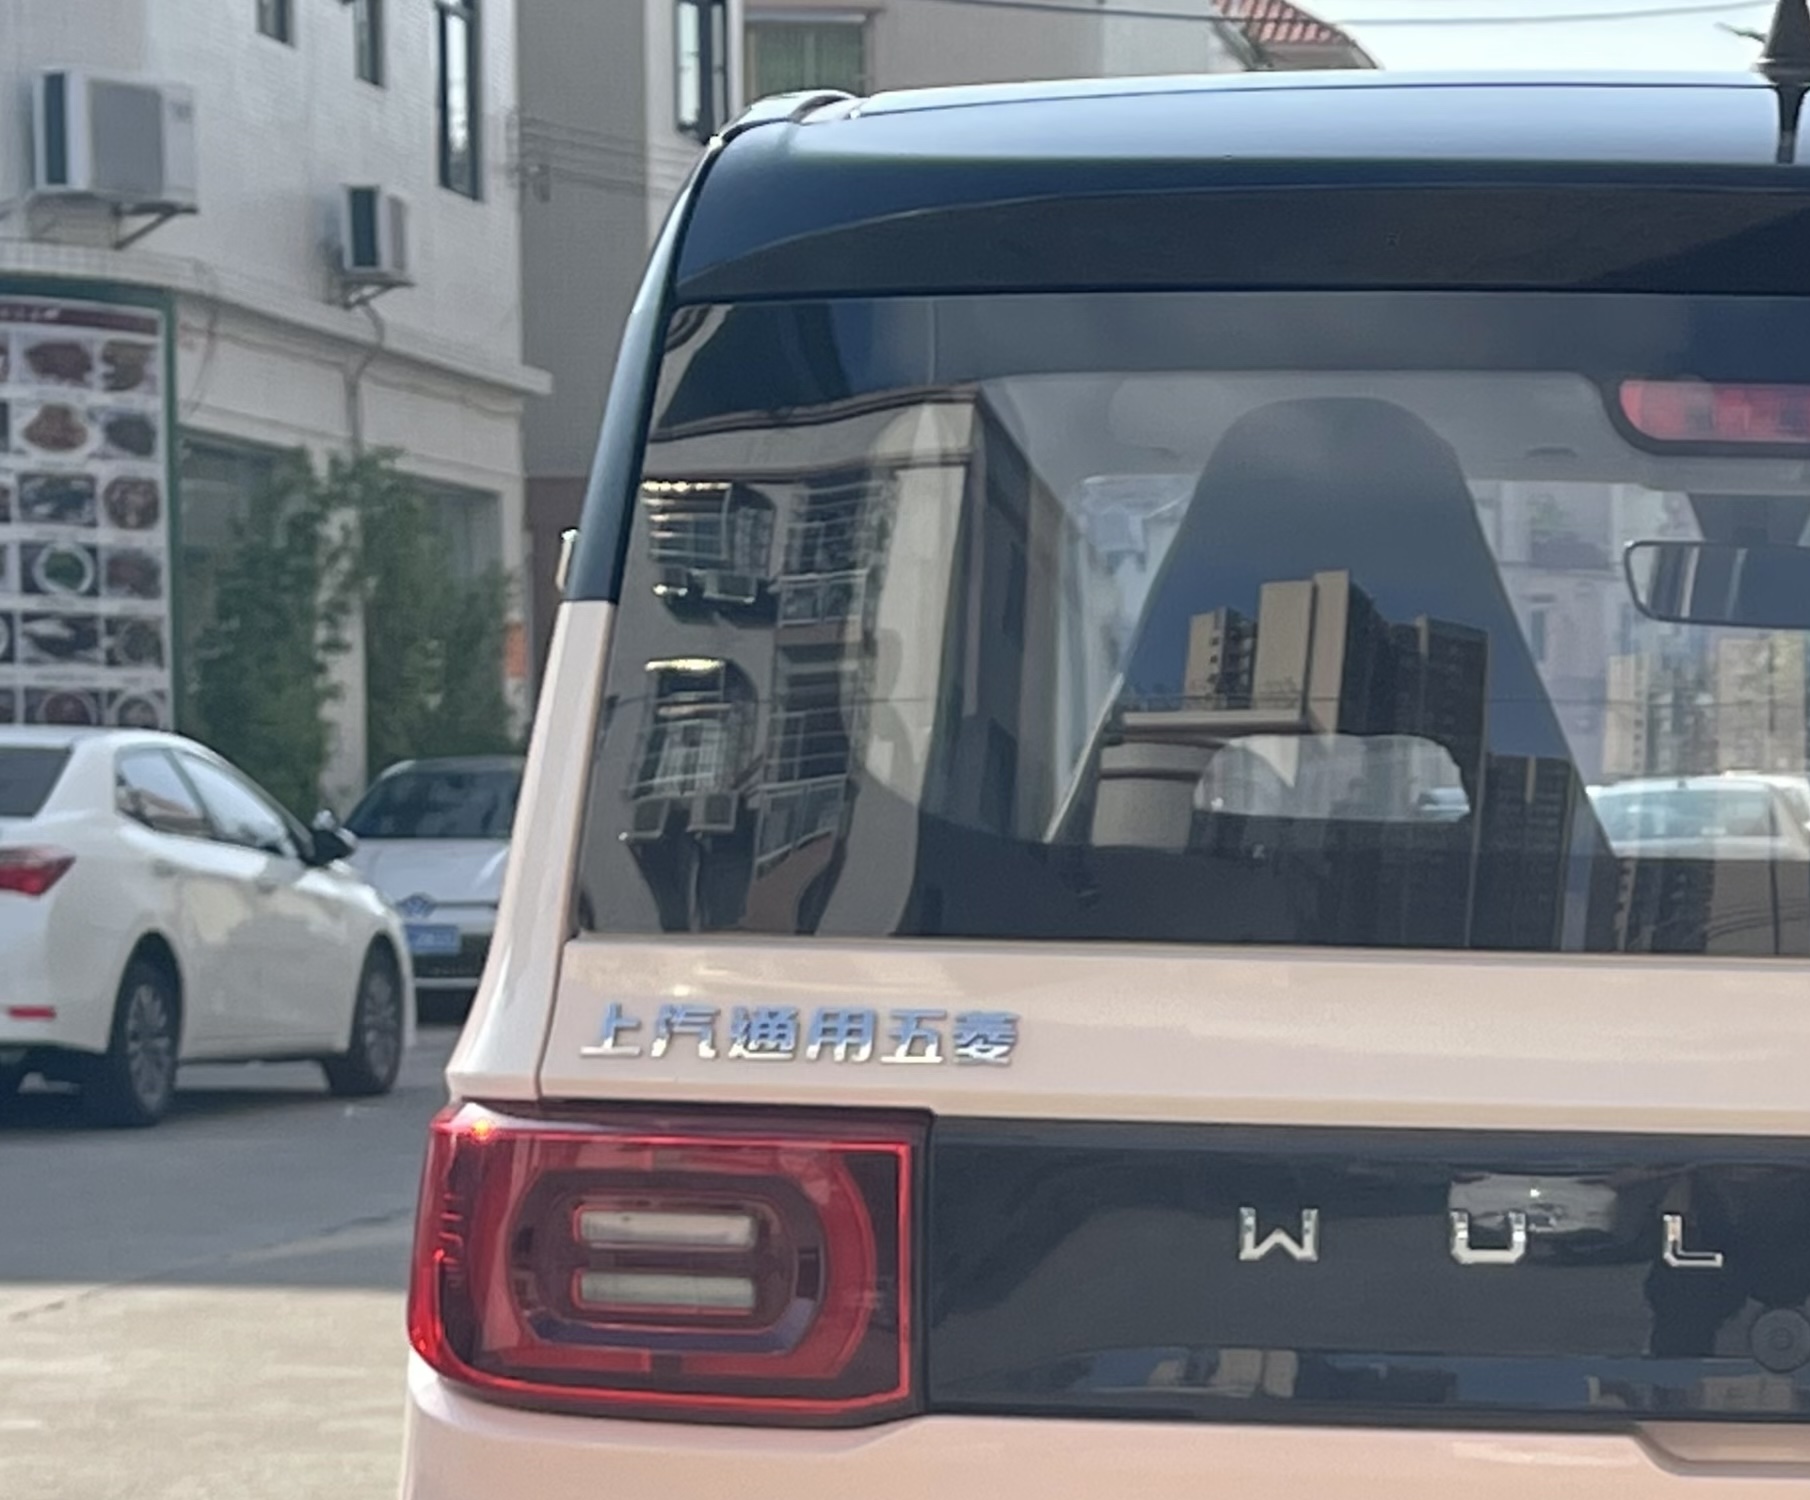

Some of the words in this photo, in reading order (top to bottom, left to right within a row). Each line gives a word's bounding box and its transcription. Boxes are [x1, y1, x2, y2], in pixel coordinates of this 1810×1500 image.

[580, 1002, 1020, 1066] 上汽通用五菱
